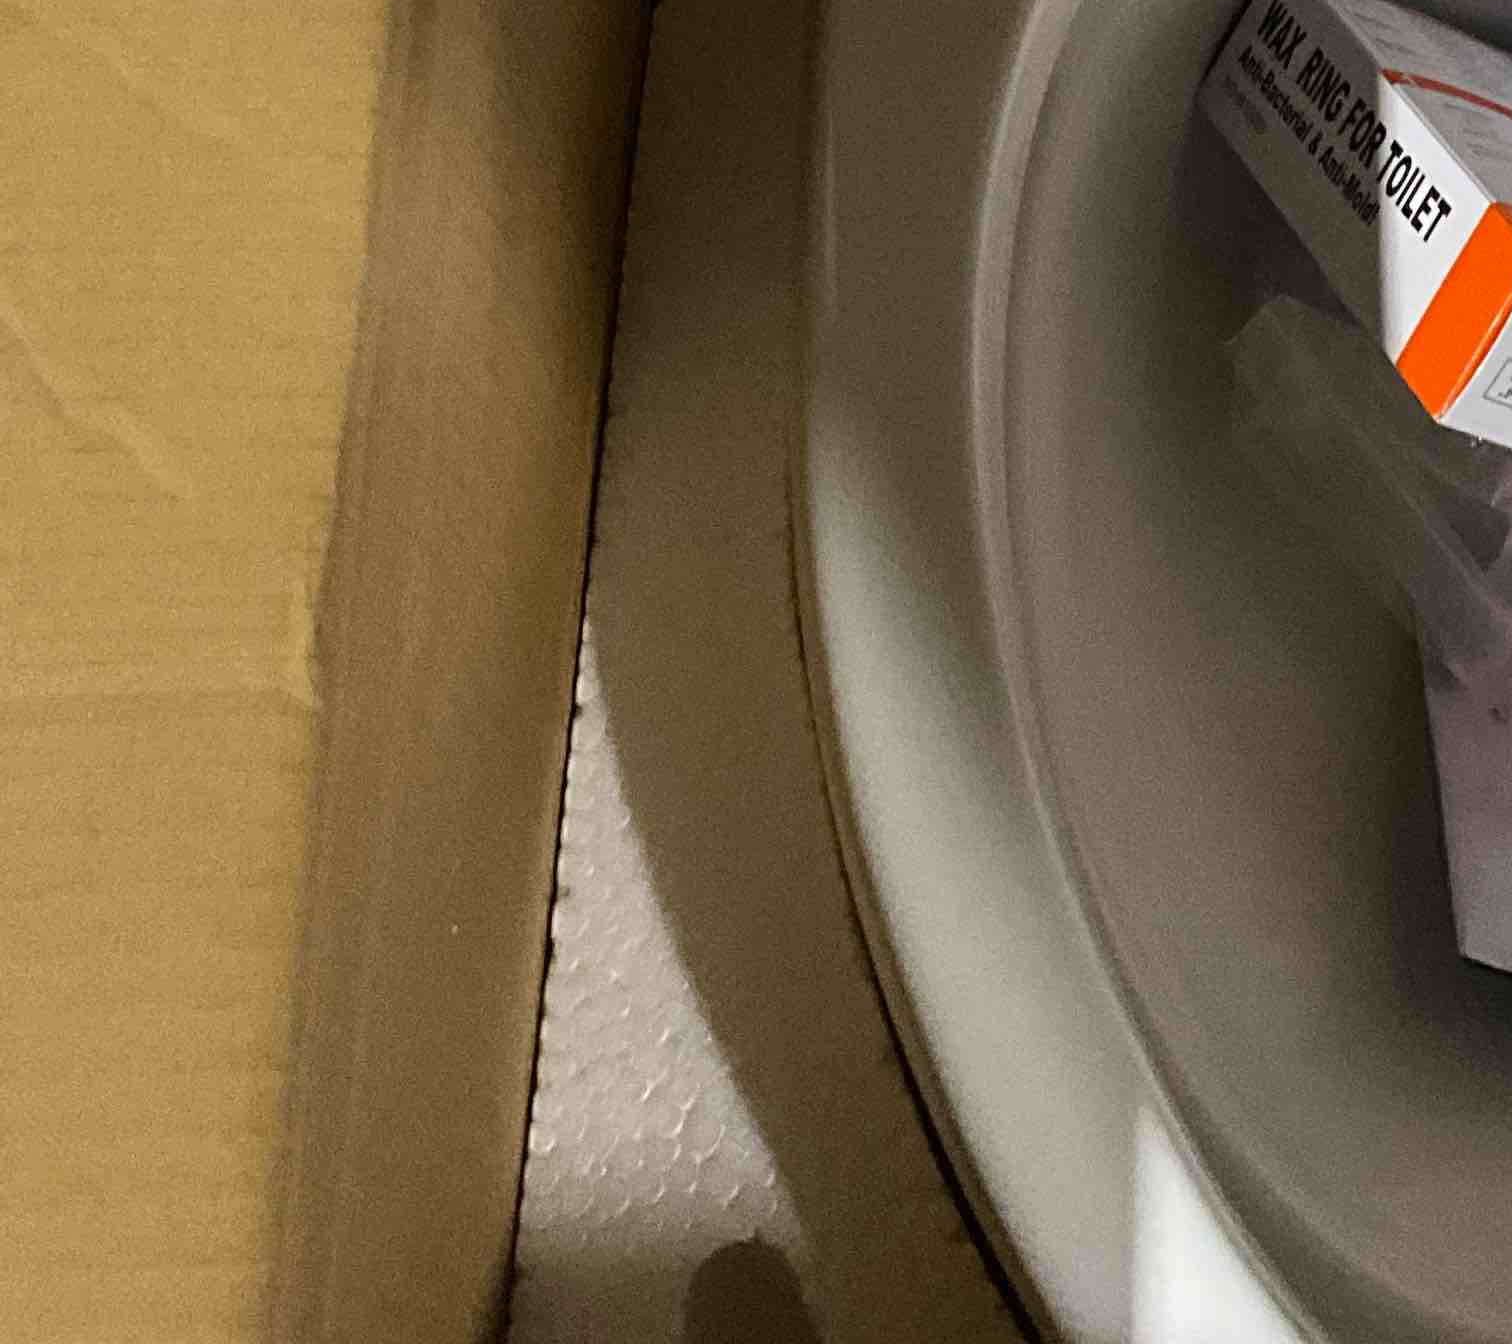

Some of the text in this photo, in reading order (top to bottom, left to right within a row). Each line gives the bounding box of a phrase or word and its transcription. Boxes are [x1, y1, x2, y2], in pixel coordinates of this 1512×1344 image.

[1297, 47, 1352, 122] RING
[1338, 98, 1387, 169] FOR
[1377, 139, 1452, 242] TOILET
